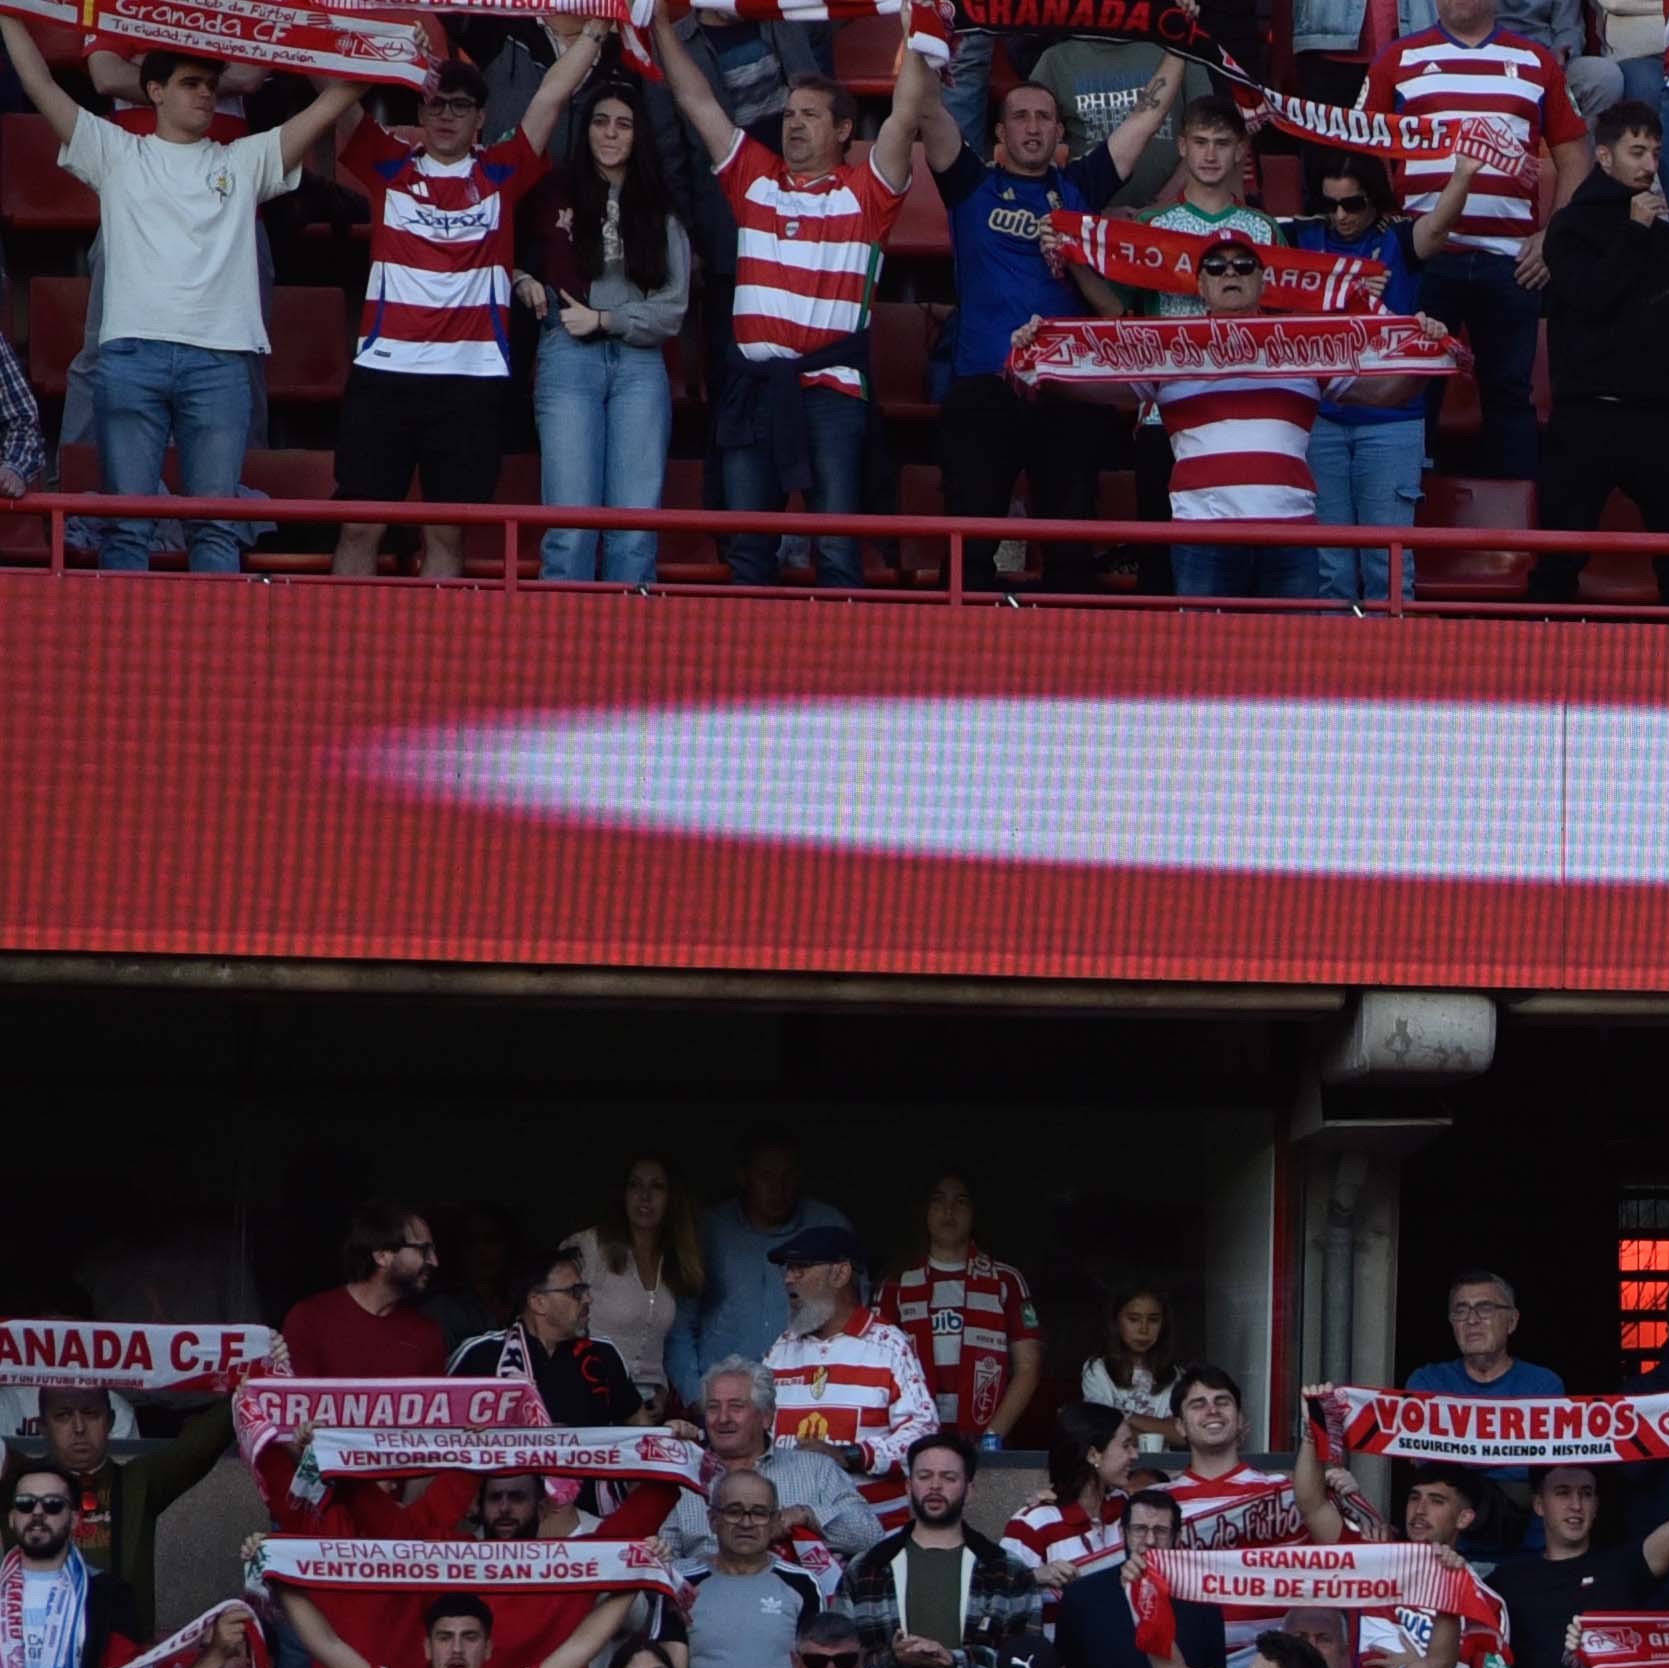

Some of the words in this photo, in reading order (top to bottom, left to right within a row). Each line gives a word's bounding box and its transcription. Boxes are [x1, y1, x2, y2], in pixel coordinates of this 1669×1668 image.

[112, 18, 128, 31] Tu
[115, 0, 242, 37] Granada
[253, 21, 294, 42] CF
[966, 0, 1148, 30] GRANADA
[1264, 86, 1392, 148] RANADA
[1402, 118, 1452, 151] C.F.
[0, 1327, 153, 1370] ANADA
[170, 1331, 250, 1372] C.F.
[258, 1391, 450, 1427] GRANADA
[468, 1390, 523, 1424] CF
[1376, 1397, 1639, 1441] VOLVEREMOS
[374, 1429, 426, 1449] PEÑA
[433, 1431, 581, 1449] GRANADINISTA
[1399, 1438, 1477, 1456] SEGUIREMOS
[1482, 1441, 1546, 1457] HACIENDO
[1551, 1440, 1612, 1456] HISTORIA
[338, 1449, 472, 1468] VENTORROS
[479, 1450, 507, 1468] DE
[513, 1451, 556, 1468] SAN
[563, 1445, 621, 1467] JOSÉ
[318, 1538, 385, 1560] PEÑA
[392, 1540, 568, 1560] GRANADINISTA
[1241, 1549, 1357, 1570] GRANADA
[296, 1561, 439, 1579] VENTORROS
[446, 1562, 478, 1579] DE
[484, 1562, 533, 1579] SAN
[538, 1557, 600, 1579] JOSÉ
[1201, 1576, 1268, 1597] CLUB
[1274, 1577, 1305, 1597] DE
[1312, 1572, 1404, 1599] FÚTBOL
